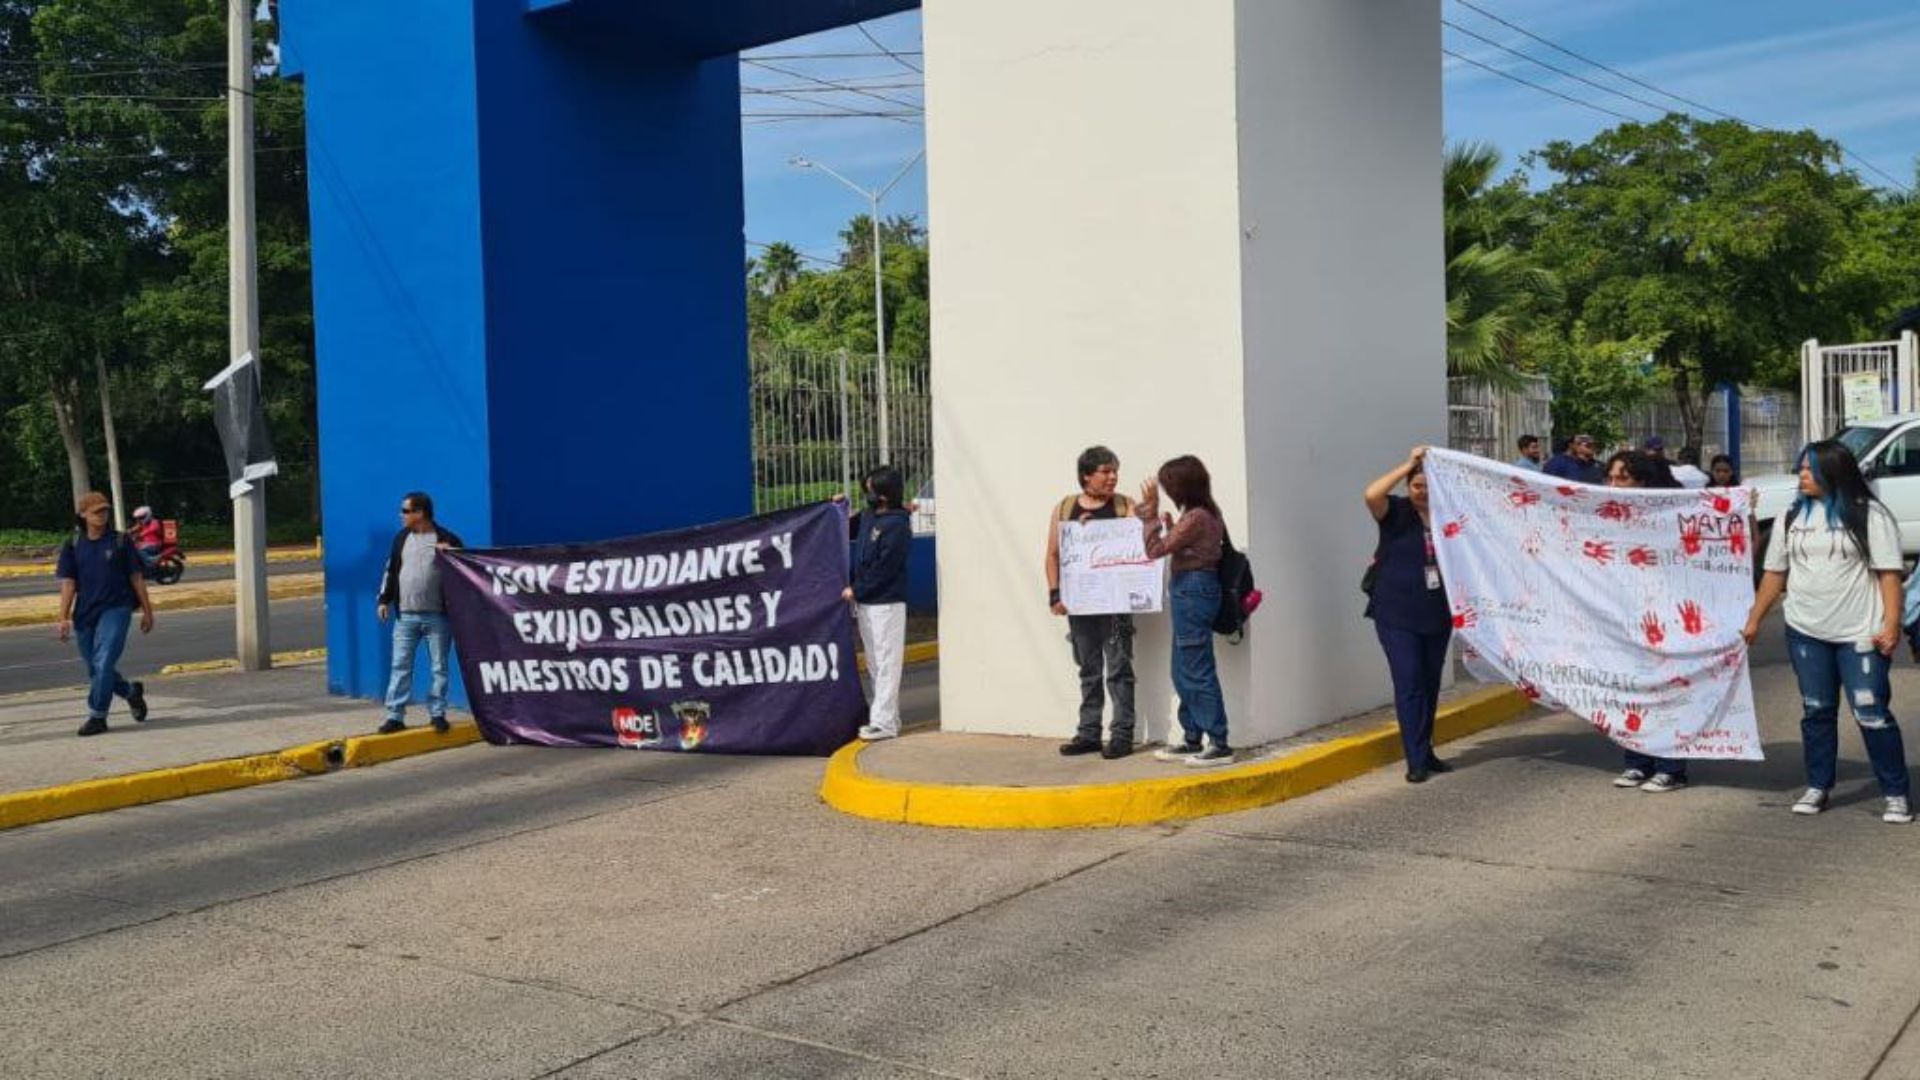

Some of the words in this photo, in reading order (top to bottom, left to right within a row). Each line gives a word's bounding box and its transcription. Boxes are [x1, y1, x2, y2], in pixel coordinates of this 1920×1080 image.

[1678, 513, 1745, 537] MATA
[565, 539, 764, 594] ESTUDIANTE
[771, 532, 793, 569] Y
[513, 608, 602, 652] EXIJO
[609, 596, 752, 639] SALONES
[762, 590, 783, 628] Y
[479, 657, 631, 694] MAESTROS
[640, 656, 683, 689] DE
[692, 643, 840, 687] CALIDAD!
[620, 715, 654, 733] MDE
